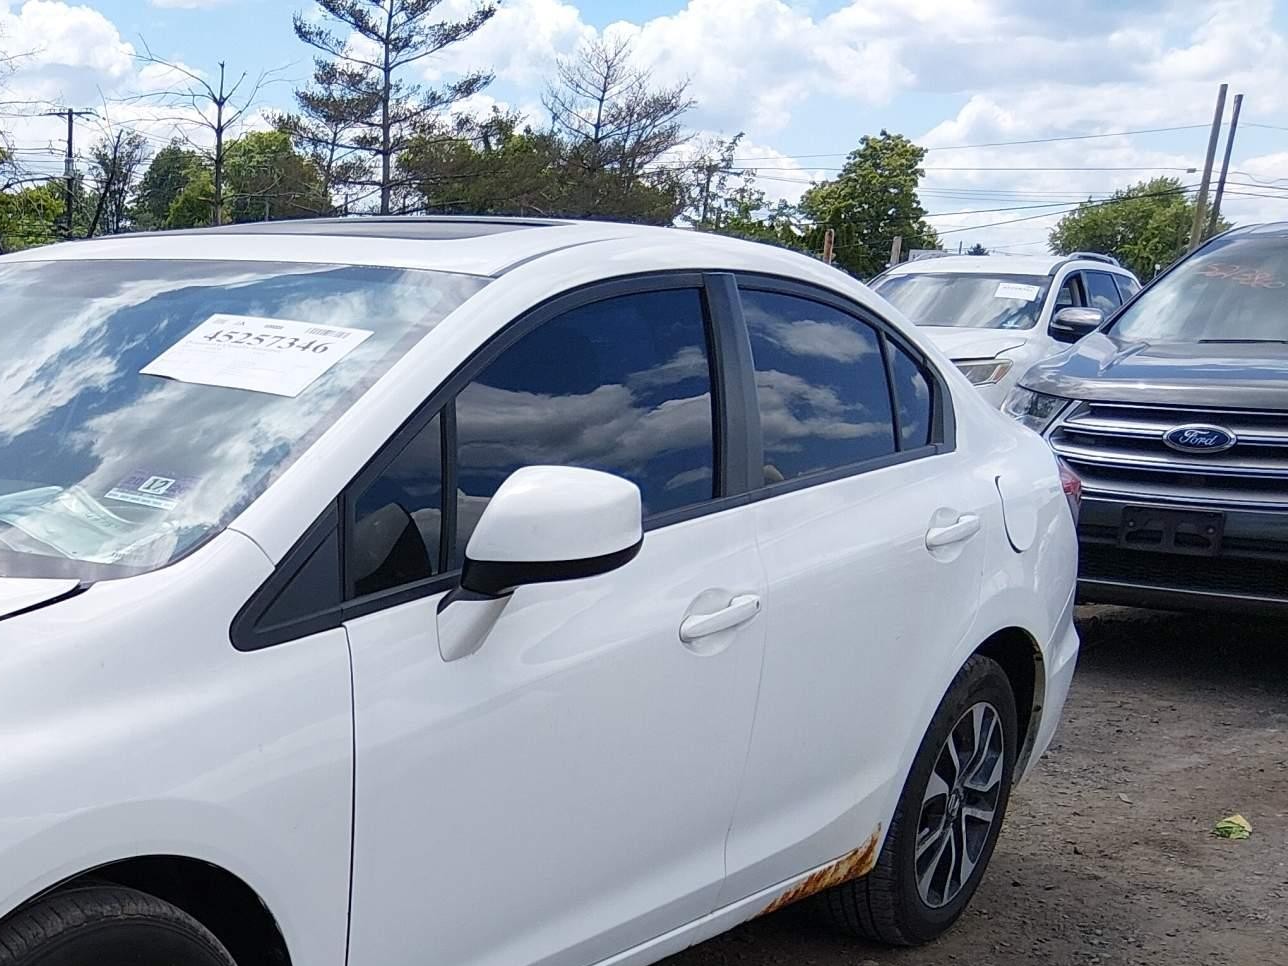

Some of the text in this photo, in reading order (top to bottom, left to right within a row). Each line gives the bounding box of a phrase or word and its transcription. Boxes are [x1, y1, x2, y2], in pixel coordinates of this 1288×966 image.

[203, 330, 330, 353] 45257346
[1178, 429, 1218, 446] Ford
[144, 478, 169, 492] 12
